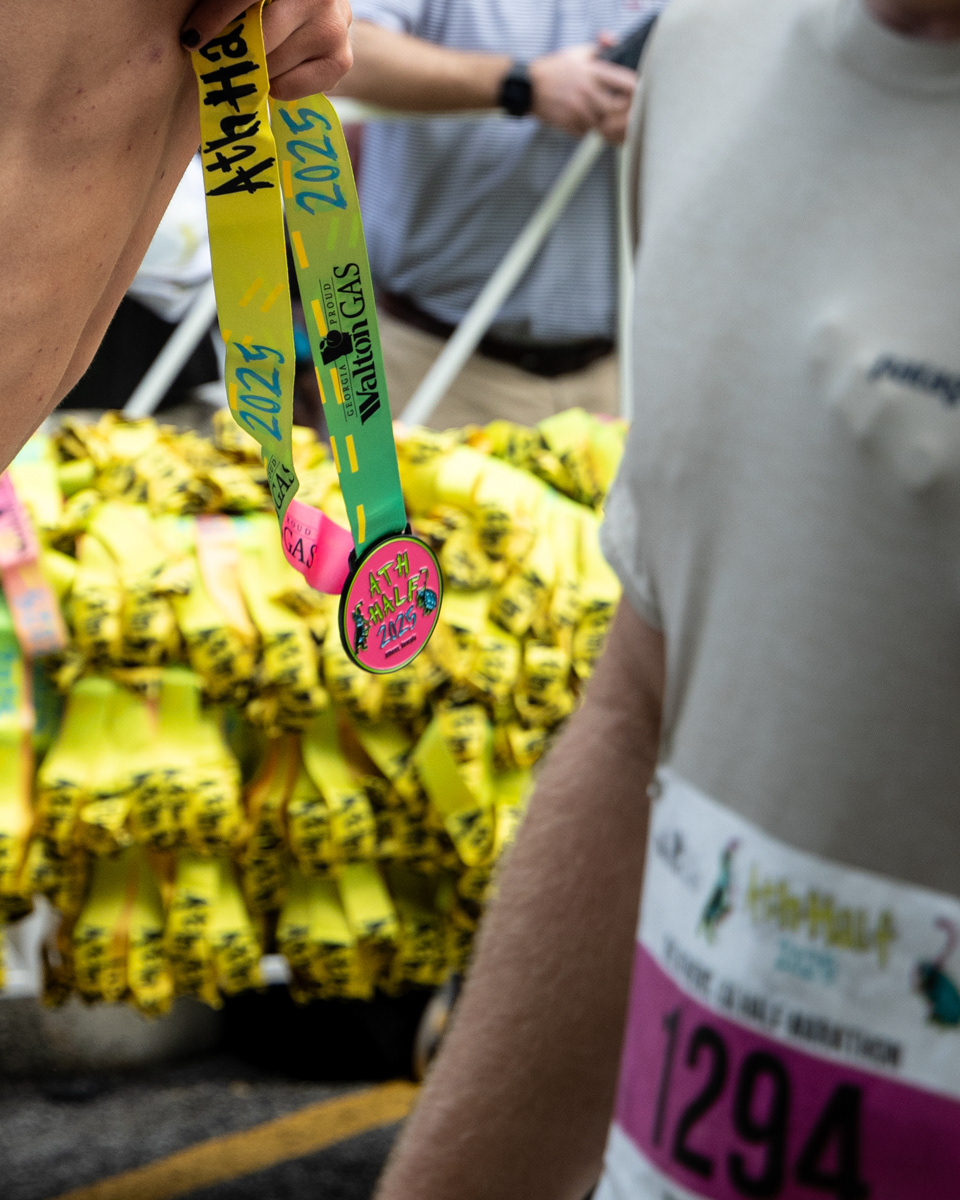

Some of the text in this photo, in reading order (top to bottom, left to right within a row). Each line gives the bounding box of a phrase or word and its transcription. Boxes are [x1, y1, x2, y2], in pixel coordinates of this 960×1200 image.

[198, 11, 275, 196] AthHa
[278, 108, 347, 215] 2025
[240, 342, 285, 442] 2025
[324, 283, 354, 417] GEORGIA PROUD
[284, 526, 317, 569] GAS
[369, 551, 409, 598] ATH
[368, 574, 420, 624] HALF
[377, 605, 416, 648] 2025
[651, 1007, 871, 1199] 1294
